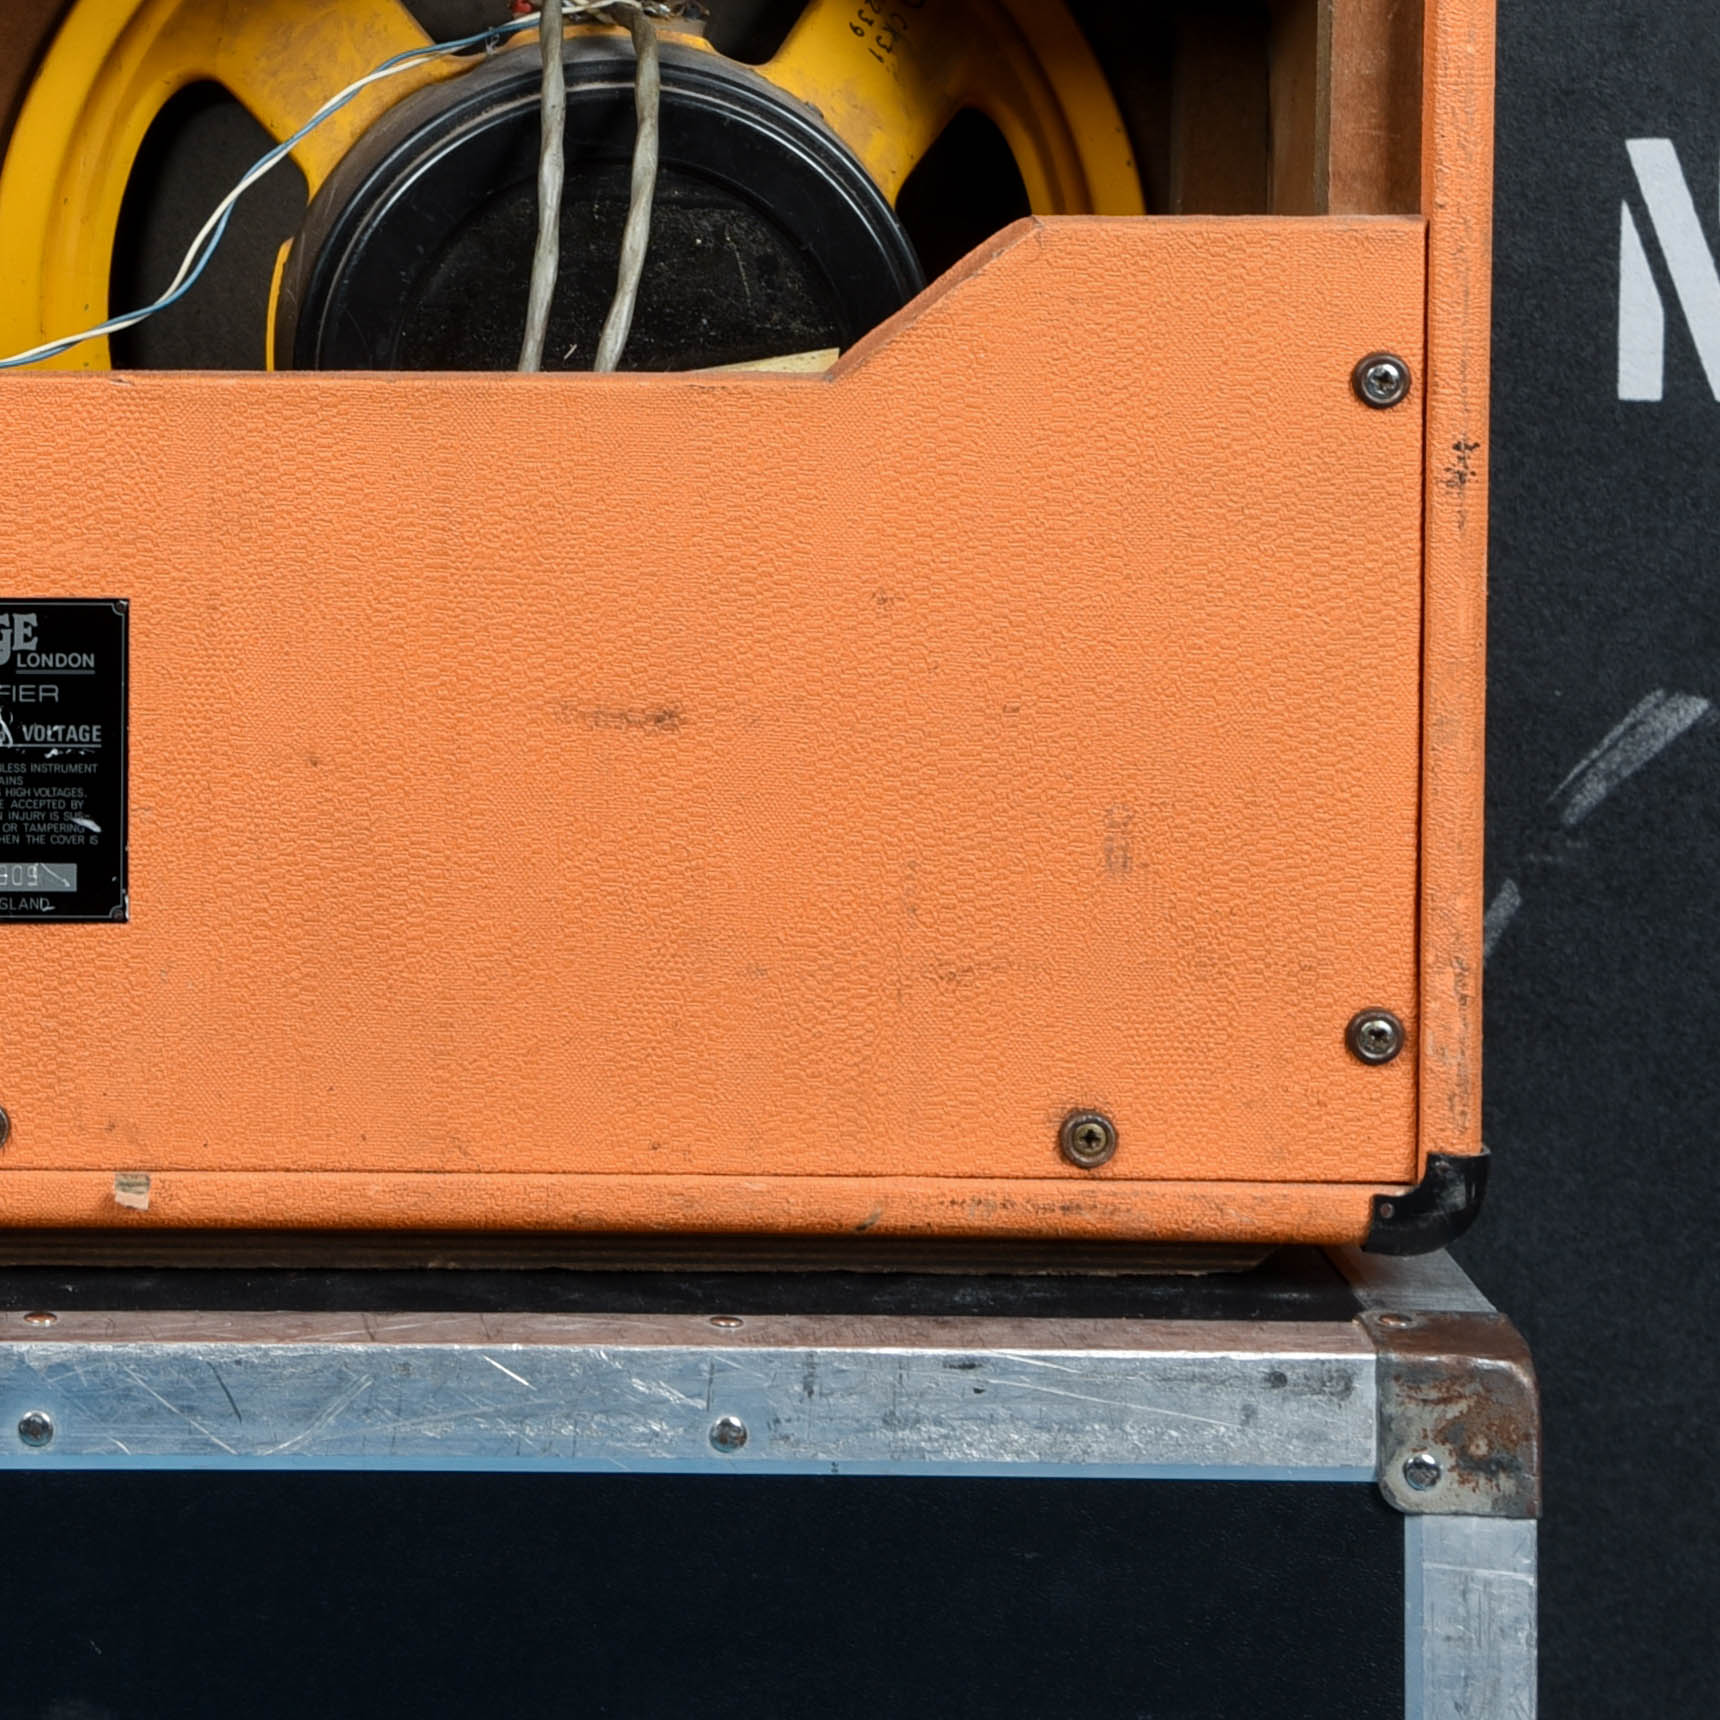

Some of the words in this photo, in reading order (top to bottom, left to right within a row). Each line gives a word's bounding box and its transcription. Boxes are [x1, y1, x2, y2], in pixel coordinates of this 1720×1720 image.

[17, 653, 95, 668] LONDON
[22, 725, 102, 742] VOLTAGE
[31, 762, 98, 773] INSTRUMENT
[5, 787, 30, 798] HIGH
[10, 799, 66, 809] ACCEPTED
[70, 799, 84, 809] BY
[8, 810, 46, 821] INJURY
[50, 810, 59, 821] IS
[2, 822, 18, 832] OR
[26, 834, 46, 844] THE
[50, 834, 85, 844] COVER
